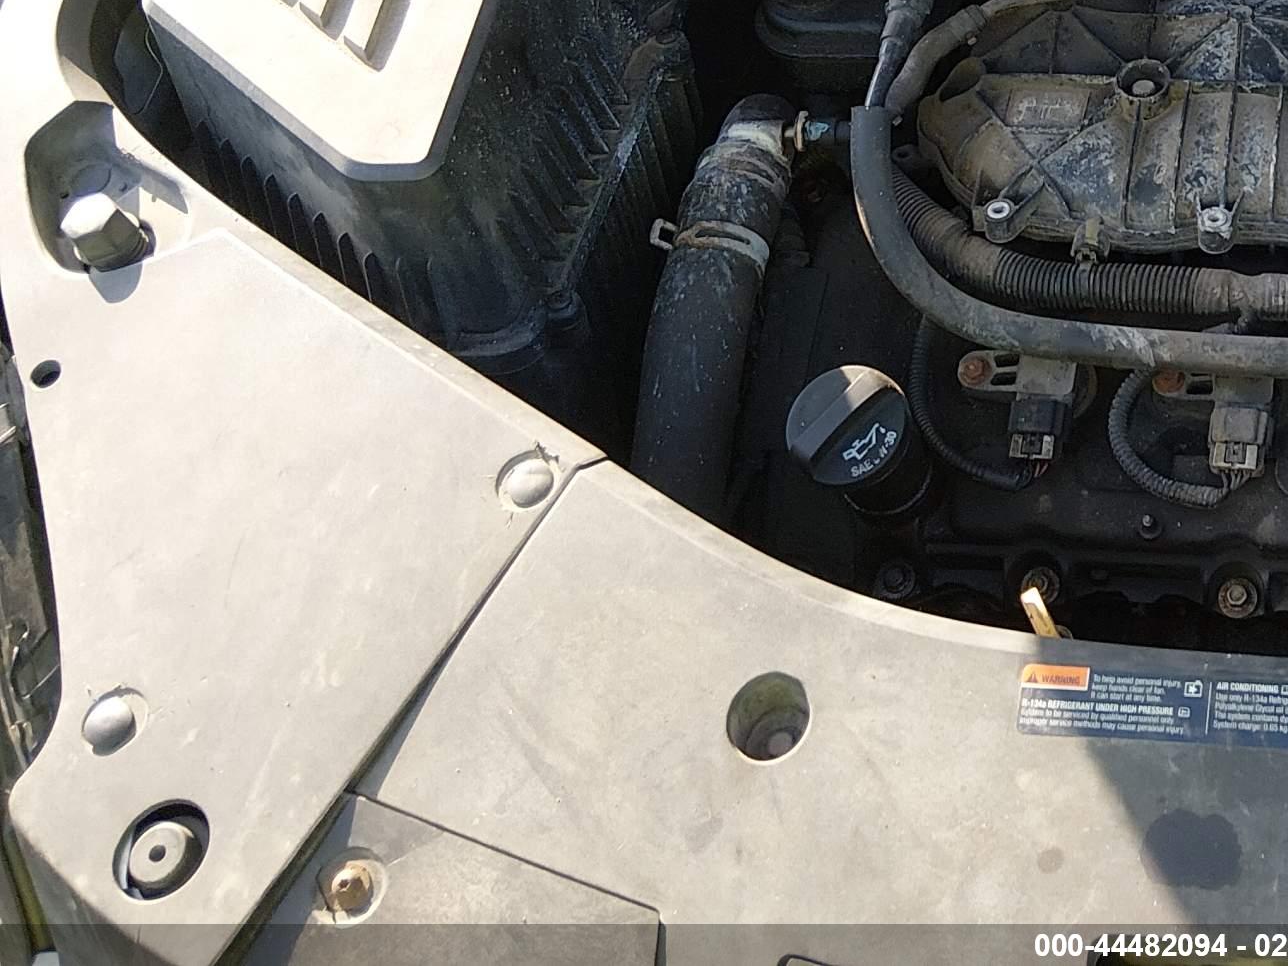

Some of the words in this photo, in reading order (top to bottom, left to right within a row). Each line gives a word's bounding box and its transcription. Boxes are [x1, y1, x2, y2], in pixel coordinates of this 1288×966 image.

[851, 458, 874, 477] SAE
[1042, 675, 1080, 683] WARNING
[1216, 682, 1229, 690] AIR
[1230, 683, 1279, 694] CONDITIONING
[1048, 700, 1094, 712] REFRIGERANT
[1095, 703, 1119, 712] UNDER
[1138, 706, 1174, 716] PRESSURE
